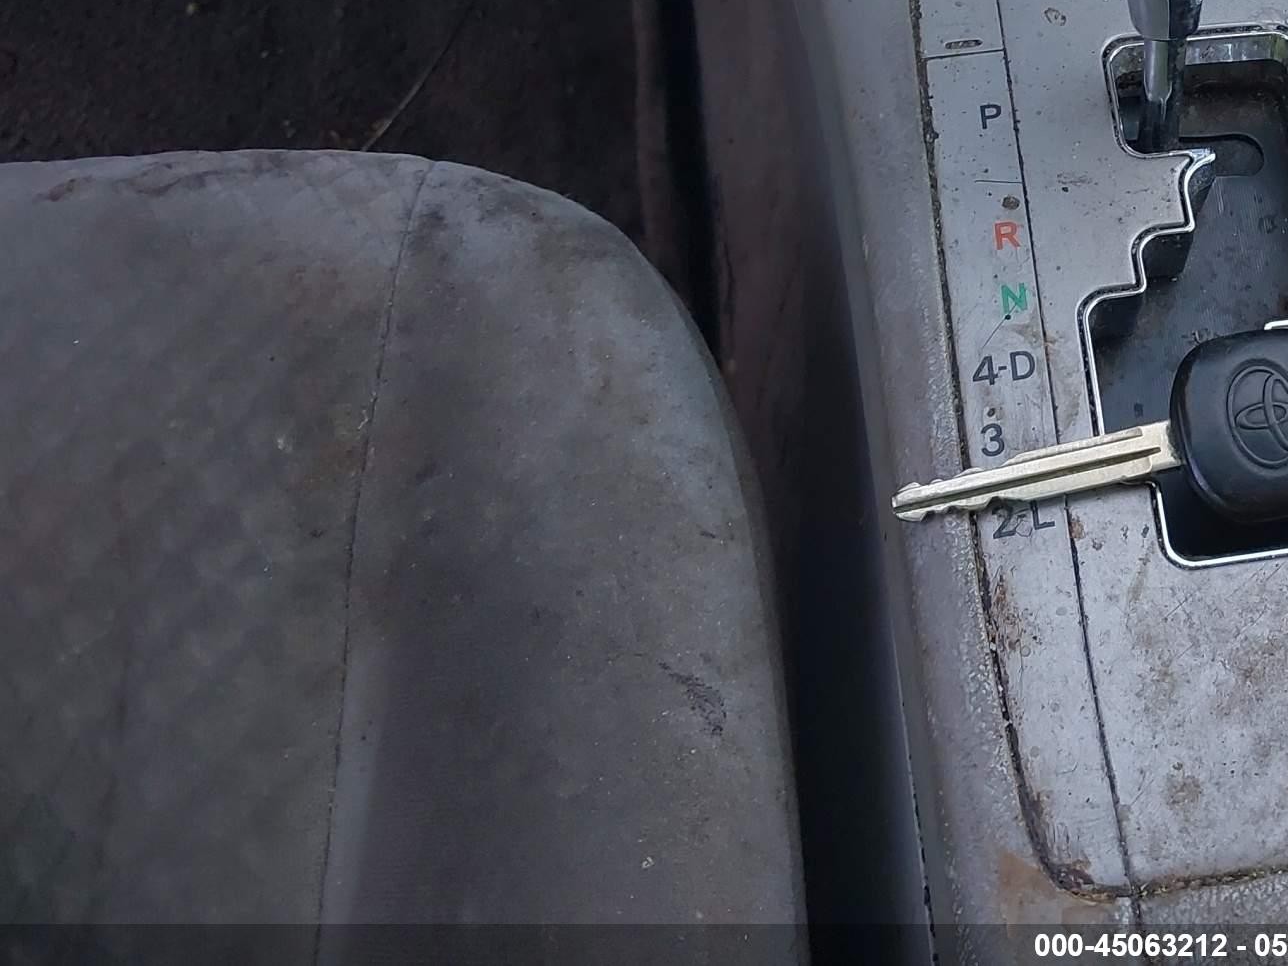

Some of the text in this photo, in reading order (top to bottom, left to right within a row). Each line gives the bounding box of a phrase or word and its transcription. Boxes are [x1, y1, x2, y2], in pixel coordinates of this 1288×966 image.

[980, 103, 1002, 130] P
[993, 221, 1021, 251] R
[1001, 282, 1029, 316] N
[972, 350, 1036, 386] 4-D
[980, 423, 1006, 457] 3
